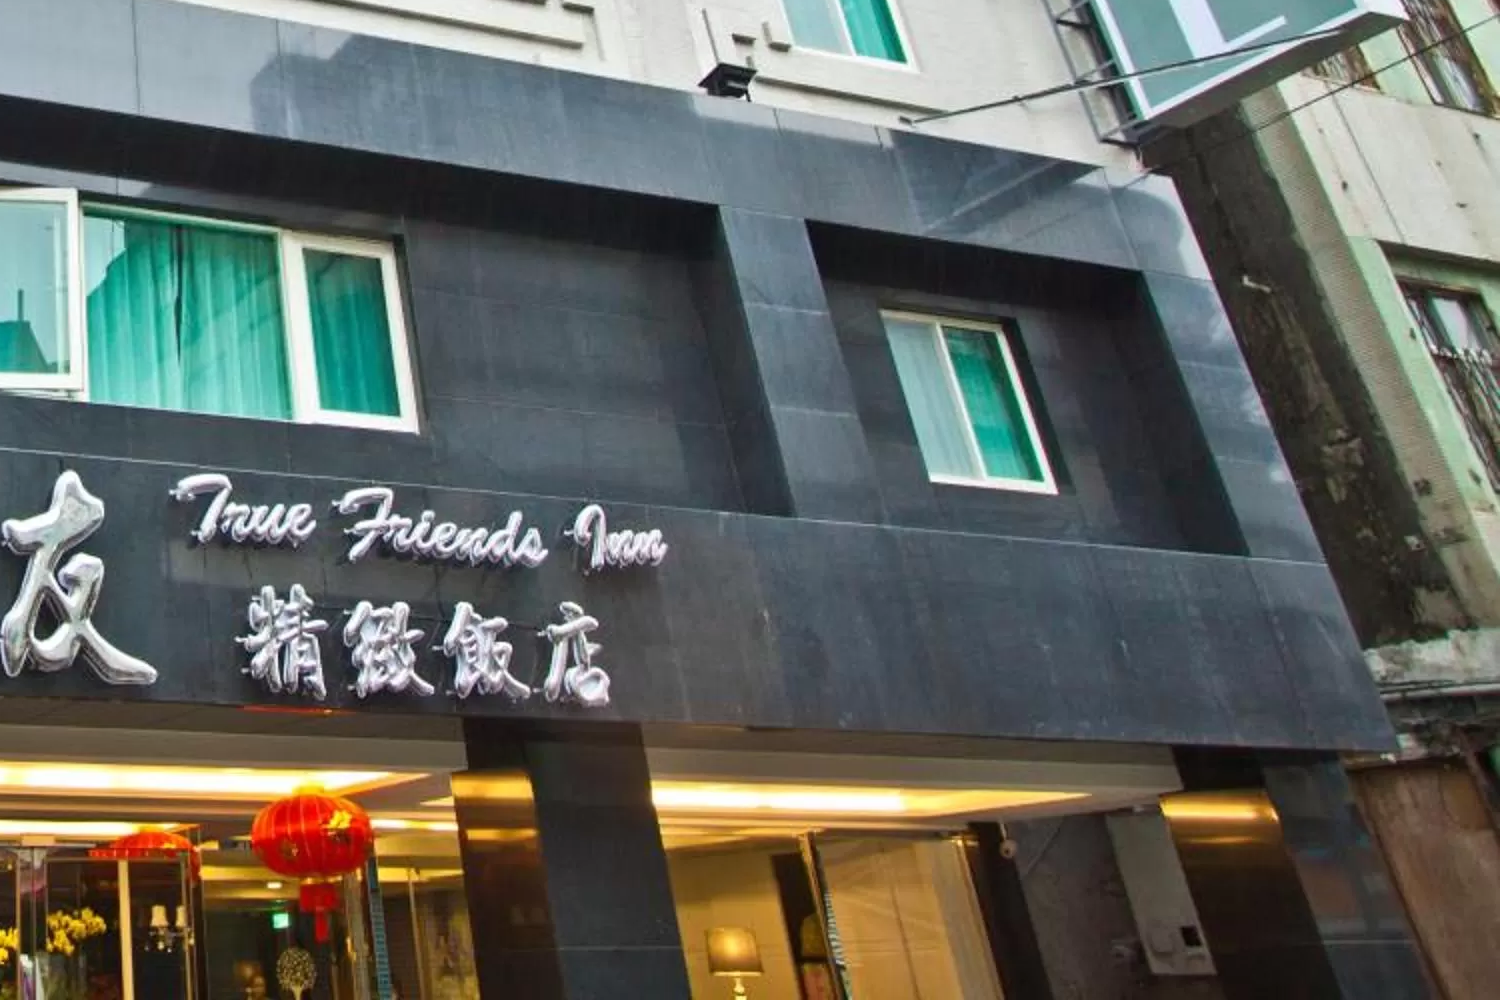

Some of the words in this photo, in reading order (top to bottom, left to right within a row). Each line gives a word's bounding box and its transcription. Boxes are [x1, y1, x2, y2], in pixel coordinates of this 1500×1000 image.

[168, 473, 317, 546] True
[331, 486, 549, 568] Friends
[564, 504, 669, 573] Inn
[236, 583, 612, 707] 精緻飯店
